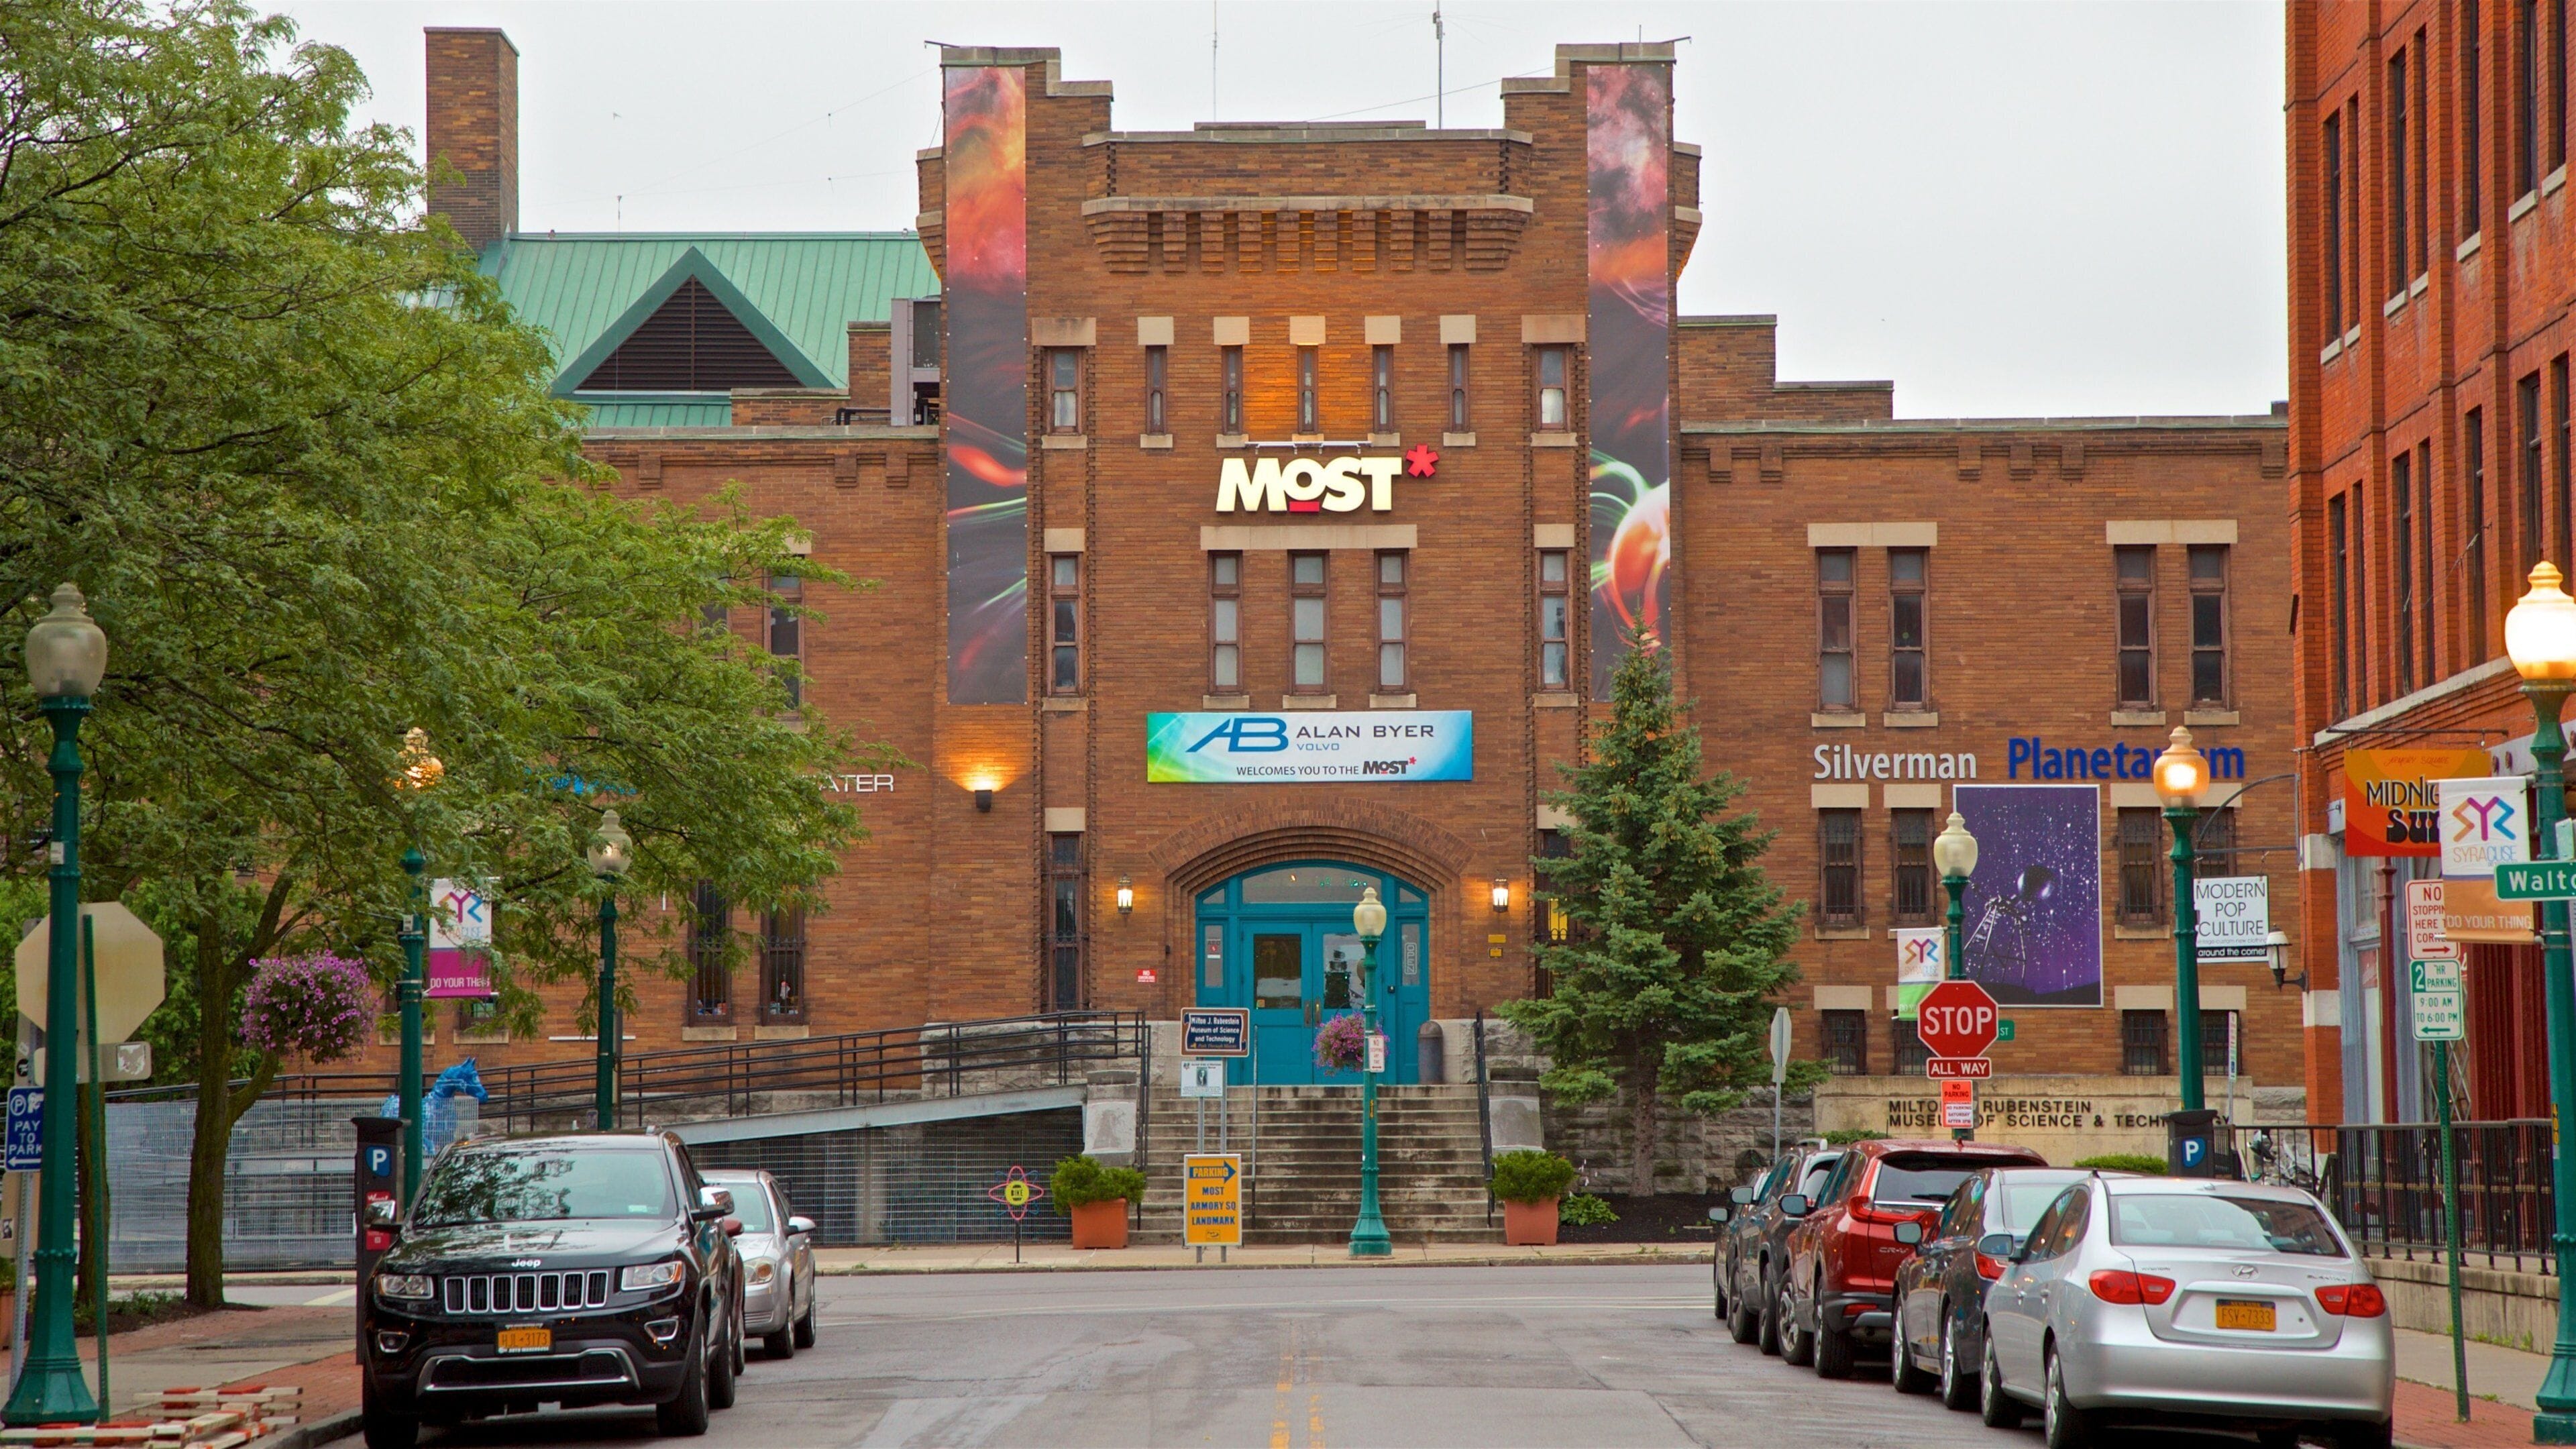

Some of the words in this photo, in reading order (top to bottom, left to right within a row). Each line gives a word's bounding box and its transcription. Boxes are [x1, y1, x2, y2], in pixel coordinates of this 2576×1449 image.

[1216, 456, 1402, 512] MOST
[1296, 725, 1360, 738] ALAN
[1373, 725, 1434, 737] BYER
[1297, 743, 1340, 751] VOLVO
[1813, 744, 1977, 780] Silverman
[2008, 737, 2245, 780] Planetam
[1236, 766, 1295, 775] WELCOMES
[1298, 766, 1320, 775] YOU
[1322, 765, 1336, 775] TO
[1338, 765, 1359, 775] THE
[1362, 759, 1408, 775] MOST
[2453, 845, 2517, 863] SYRACUSE
[2196, 883, 2265, 900] MODERN
[2423, 886, 2442, 901] NO
[2216, 902, 2246, 917] POP
[2199, 920, 2263, 936] CULTURE
[2415, 919, 2438, 929] HERE
[2446, 916, 2462, 928] DO
[2465, 916, 2496, 928] YOUR
[2498, 915, 2532, 929] THING
[2198, 948, 2225, 957] around
[2227, 947, 2239, 956] the
[2436, 965, 2446, 974] HR
[430, 978, 441, 988] DO
[443, 977, 464, 988] YOUR
[2415, 965, 2424, 989] 2
[2427, 977, 2457, 987] PARKING
[2420, 998, 2438, 1006] 9:00
[2443, 998, 2453, 1006] AM
[1924, 1006, 1992, 1035] STOP
[2416, 1014, 2424, 1022] TO
[2427, 1013, 2445, 1022] 6:00
[2449, 1013, 2458, 1022] PM
[2000, 1027, 2008, 1036] ST
[1205, 1035, 1235, 1043] Technology
[1931, 1062, 1955, 1075] ALL
[1961, 1062, 1988, 1075] WAY
[1983, 1100, 2091, 1113] RUBENSTEIN
[15, 1120, 40, 1132] PAY
[2007, 1114, 2082, 1127] SCIENCE
[2093, 1114, 2104, 1127] &
[19, 1132, 36, 1144] TO
[8, 1144, 42, 1155] PARK
[2185, 1140, 2199, 1161] P
[373, 1149, 387, 1171] P
[1193, 1167, 1228, 1177] PARKING
[1202, 1187, 1224, 1195] MOST
[1191, 1201, 1224, 1210] ARMORY
[1226, 1201, 1236, 1210] SQ
[1191, 1216, 1235, 1225] LANDMARK
[511, 1258, 541, 1269] Jeep
